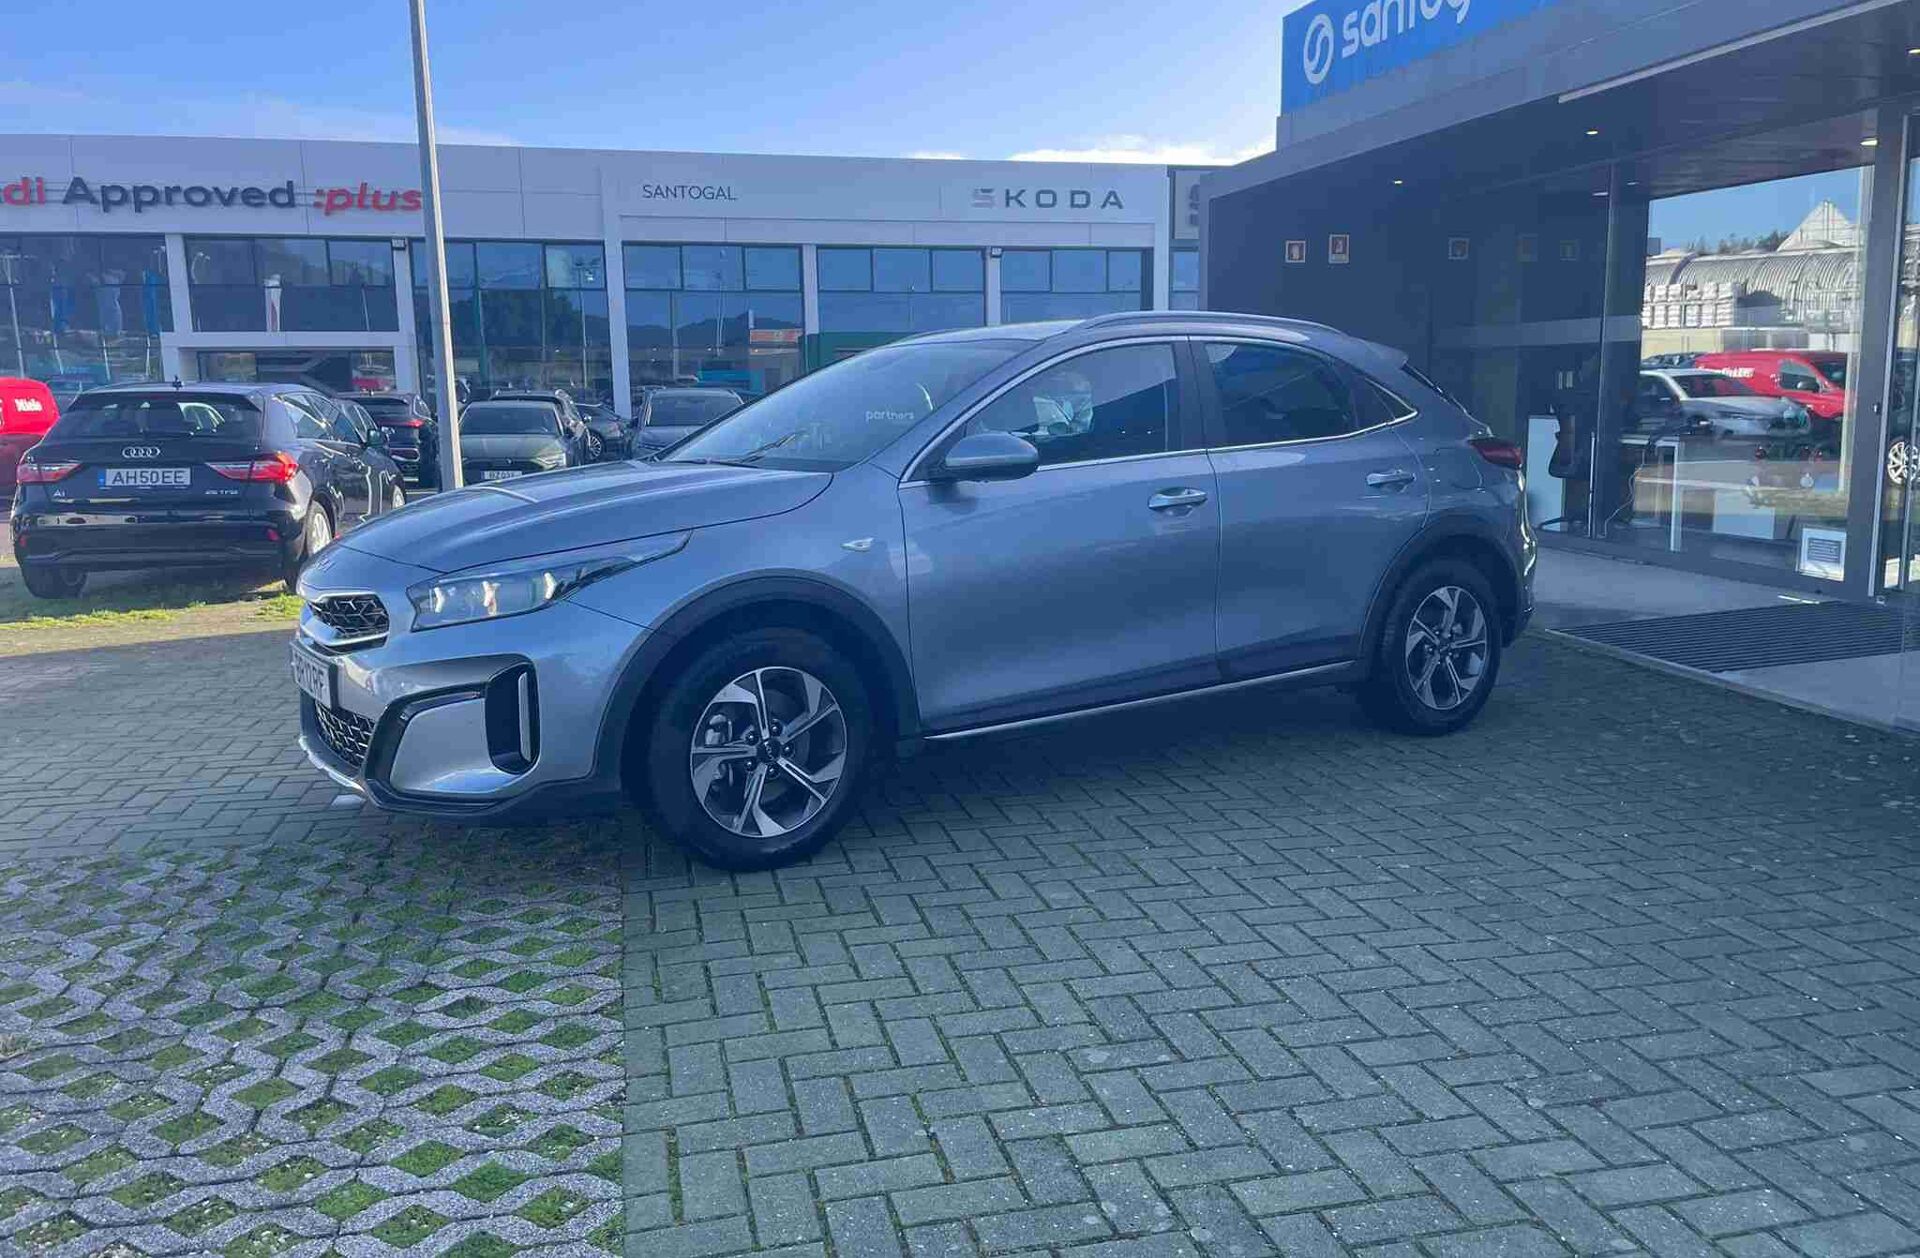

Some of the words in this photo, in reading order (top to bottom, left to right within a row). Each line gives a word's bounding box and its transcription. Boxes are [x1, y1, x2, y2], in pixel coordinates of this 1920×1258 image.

[0, 177, 46, 206] di
[62, 176, 296, 214] Approved
[642, 184, 738, 201] SANTOGAL
[111, 470, 185, 485] AH50EE
